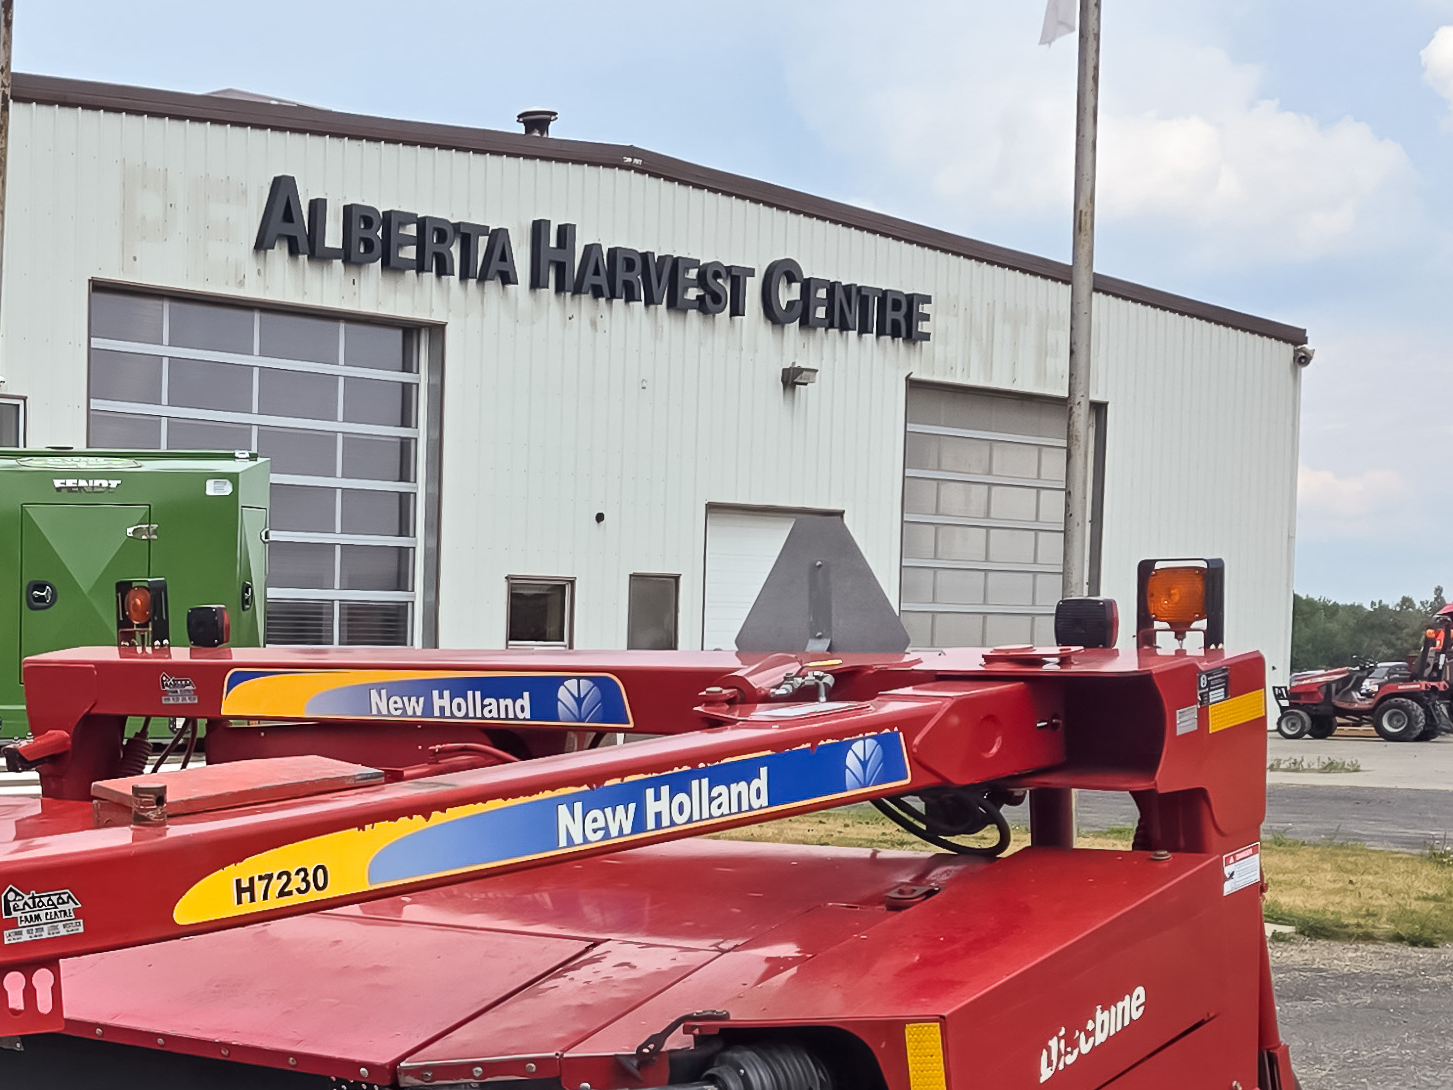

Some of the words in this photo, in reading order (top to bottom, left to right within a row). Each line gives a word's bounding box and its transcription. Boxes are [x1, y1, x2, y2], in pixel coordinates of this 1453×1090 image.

[254, 174, 518, 286] ALBERTA
[531, 218, 756, 318] HARVEST
[761, 257, 933, 342] CENTRE
[52, 478, 122, 493] FENDT
[369, 688, 424, 716] New
[432, 690, 531, 719] Holland
[557, 801, 636, 848] New
[645, 766, 769, 831] Holland
[234, 863, 330, 906] H7230
[19, 913, 43, 925] FARM
